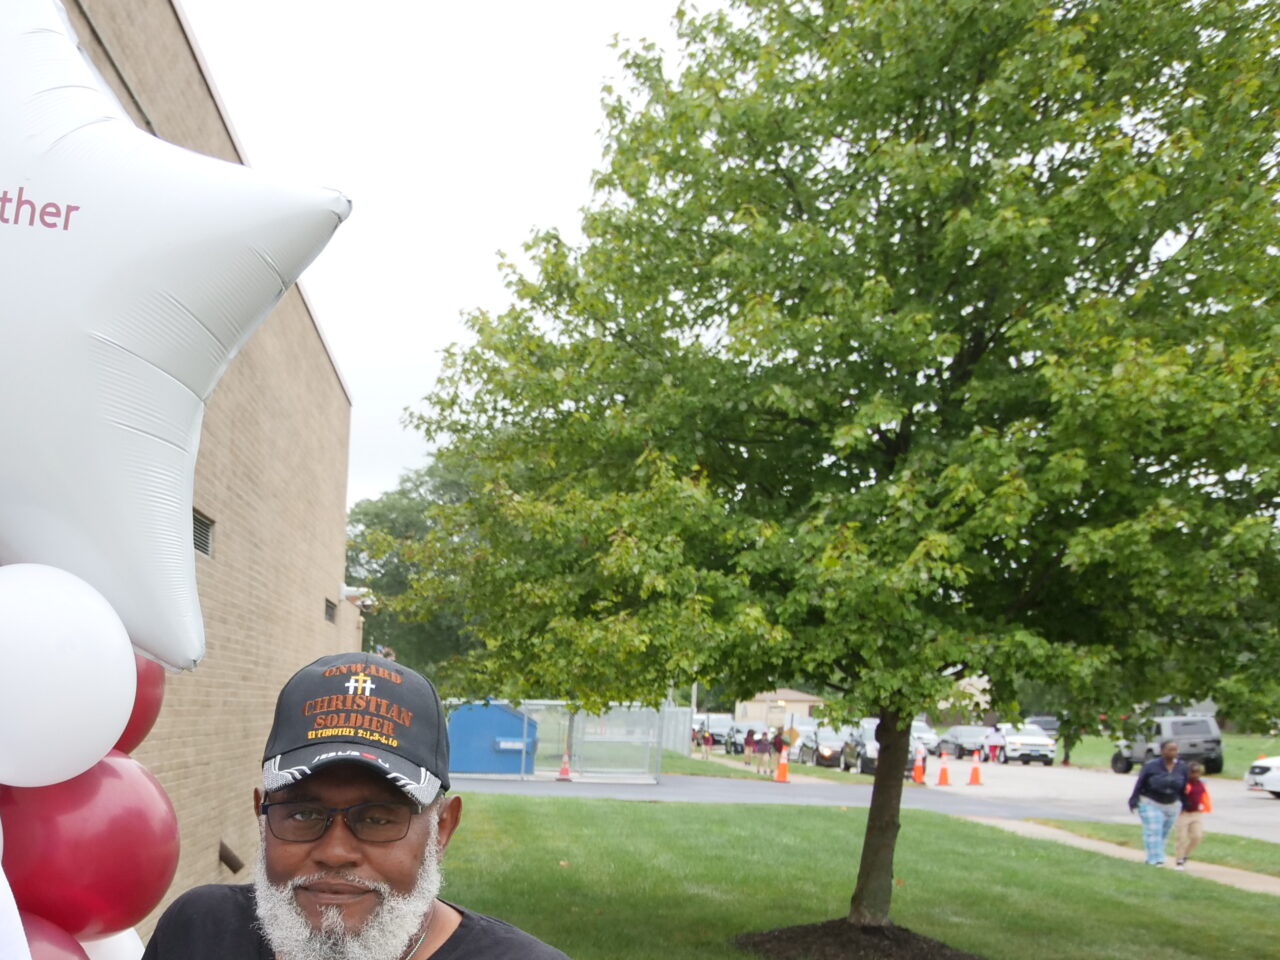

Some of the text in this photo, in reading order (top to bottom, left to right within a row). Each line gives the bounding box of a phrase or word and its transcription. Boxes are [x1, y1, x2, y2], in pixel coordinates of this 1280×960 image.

[322, 663, 403, 685] ONWARD
[303, 694, 414, 728] CHRISTIAN
[314, 712, 396, 737] SOLDIER
[317, 727, 356, 738] TIMOTHY
